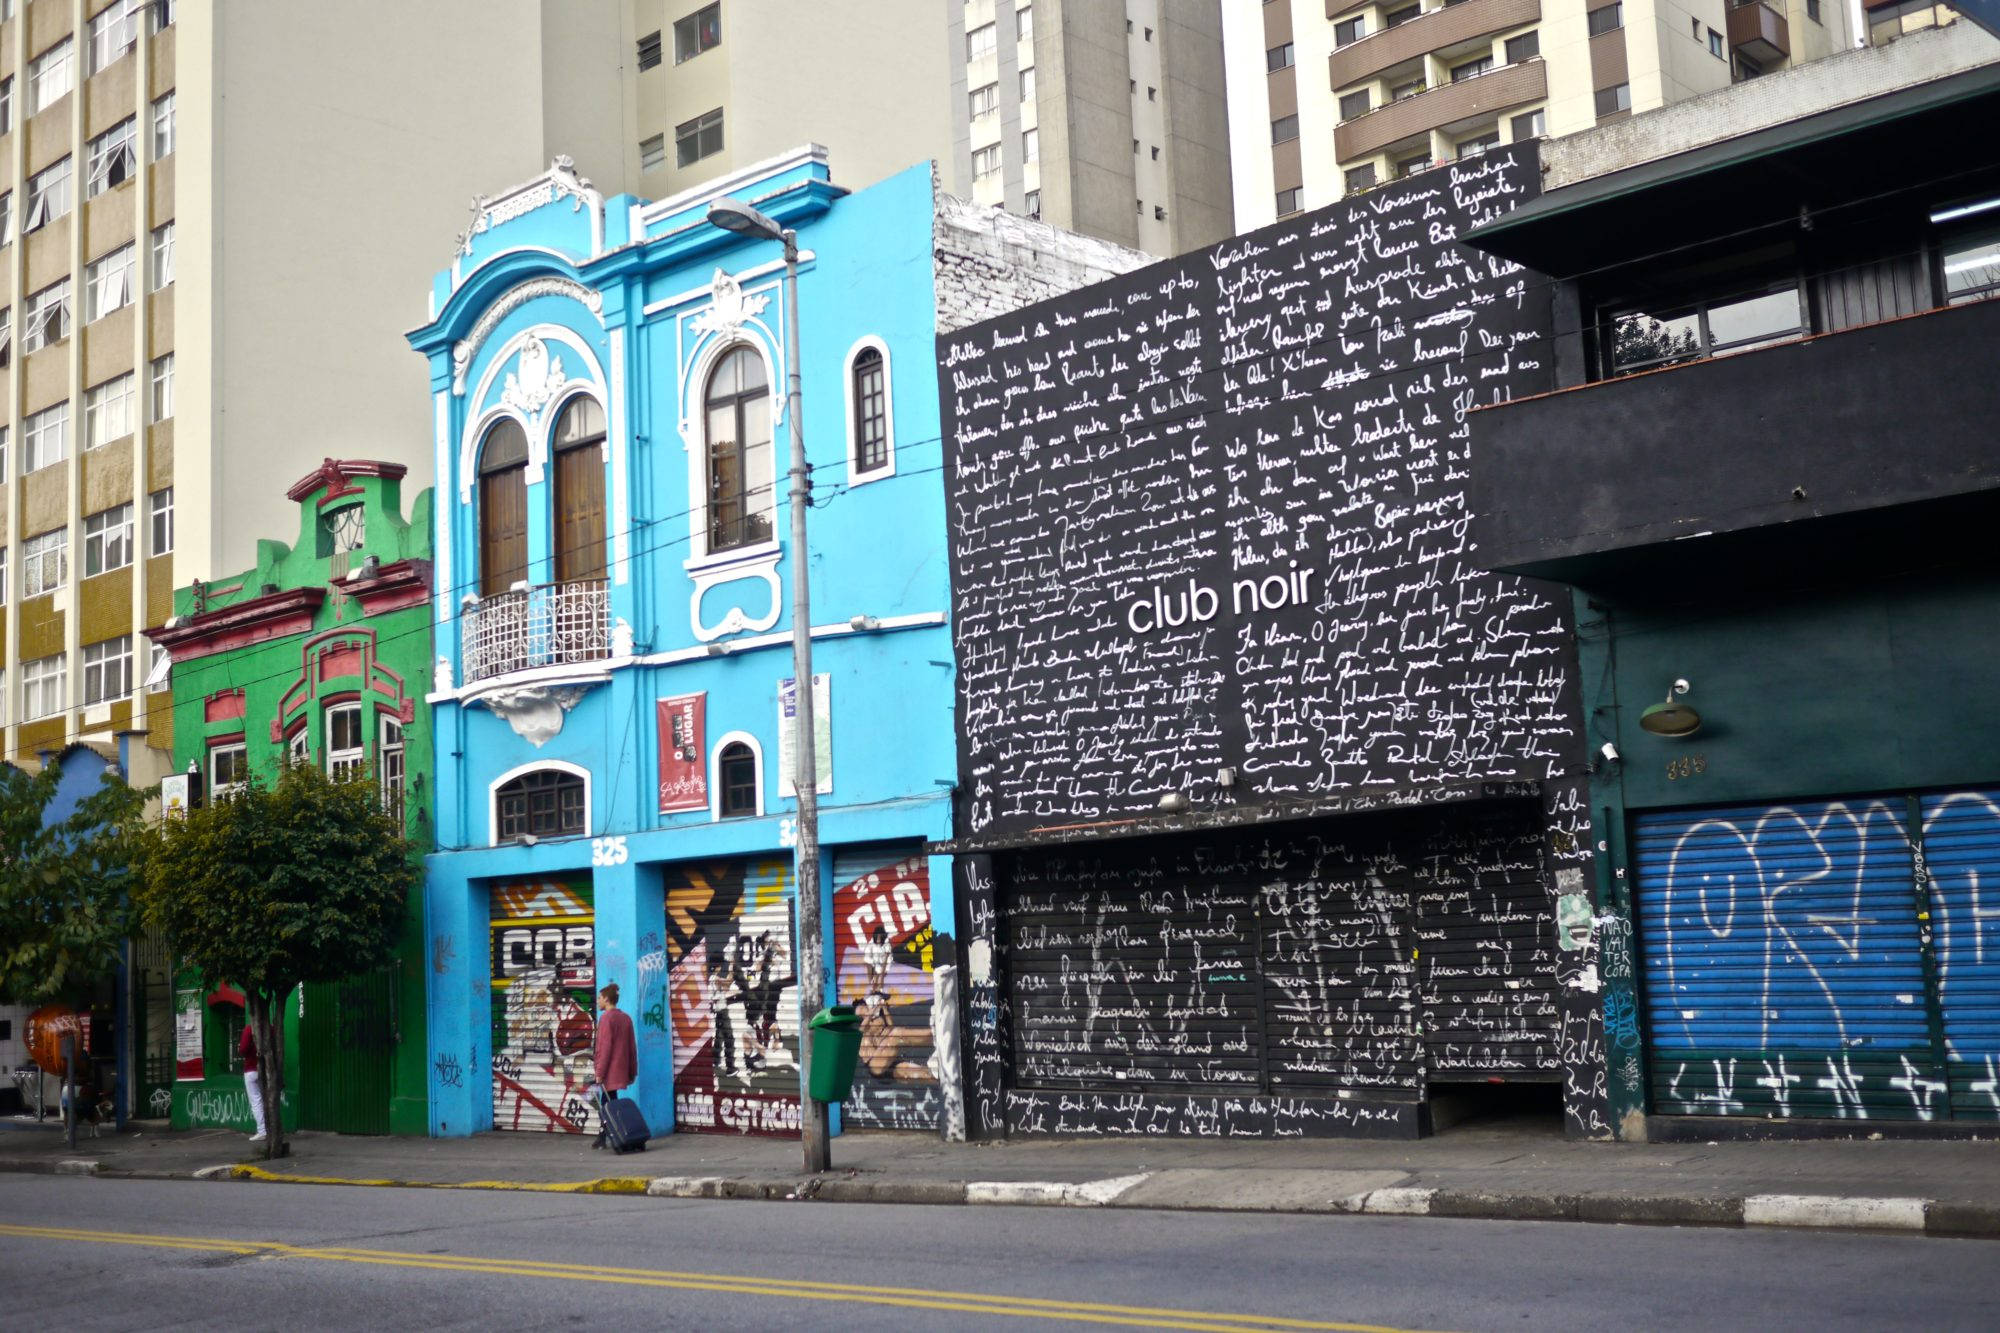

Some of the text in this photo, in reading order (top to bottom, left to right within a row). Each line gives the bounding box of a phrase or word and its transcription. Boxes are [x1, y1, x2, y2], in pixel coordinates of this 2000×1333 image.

[1128, 560, 1314, 633] club noir
[683, 704, 694, 744] LUGAR
[592, 836, 628, 866] 325
[1605, 936, 1626, 951] VAI
[1605, 951, 1631, 965] TER
[1605, 965, 1631, 977] COPA
